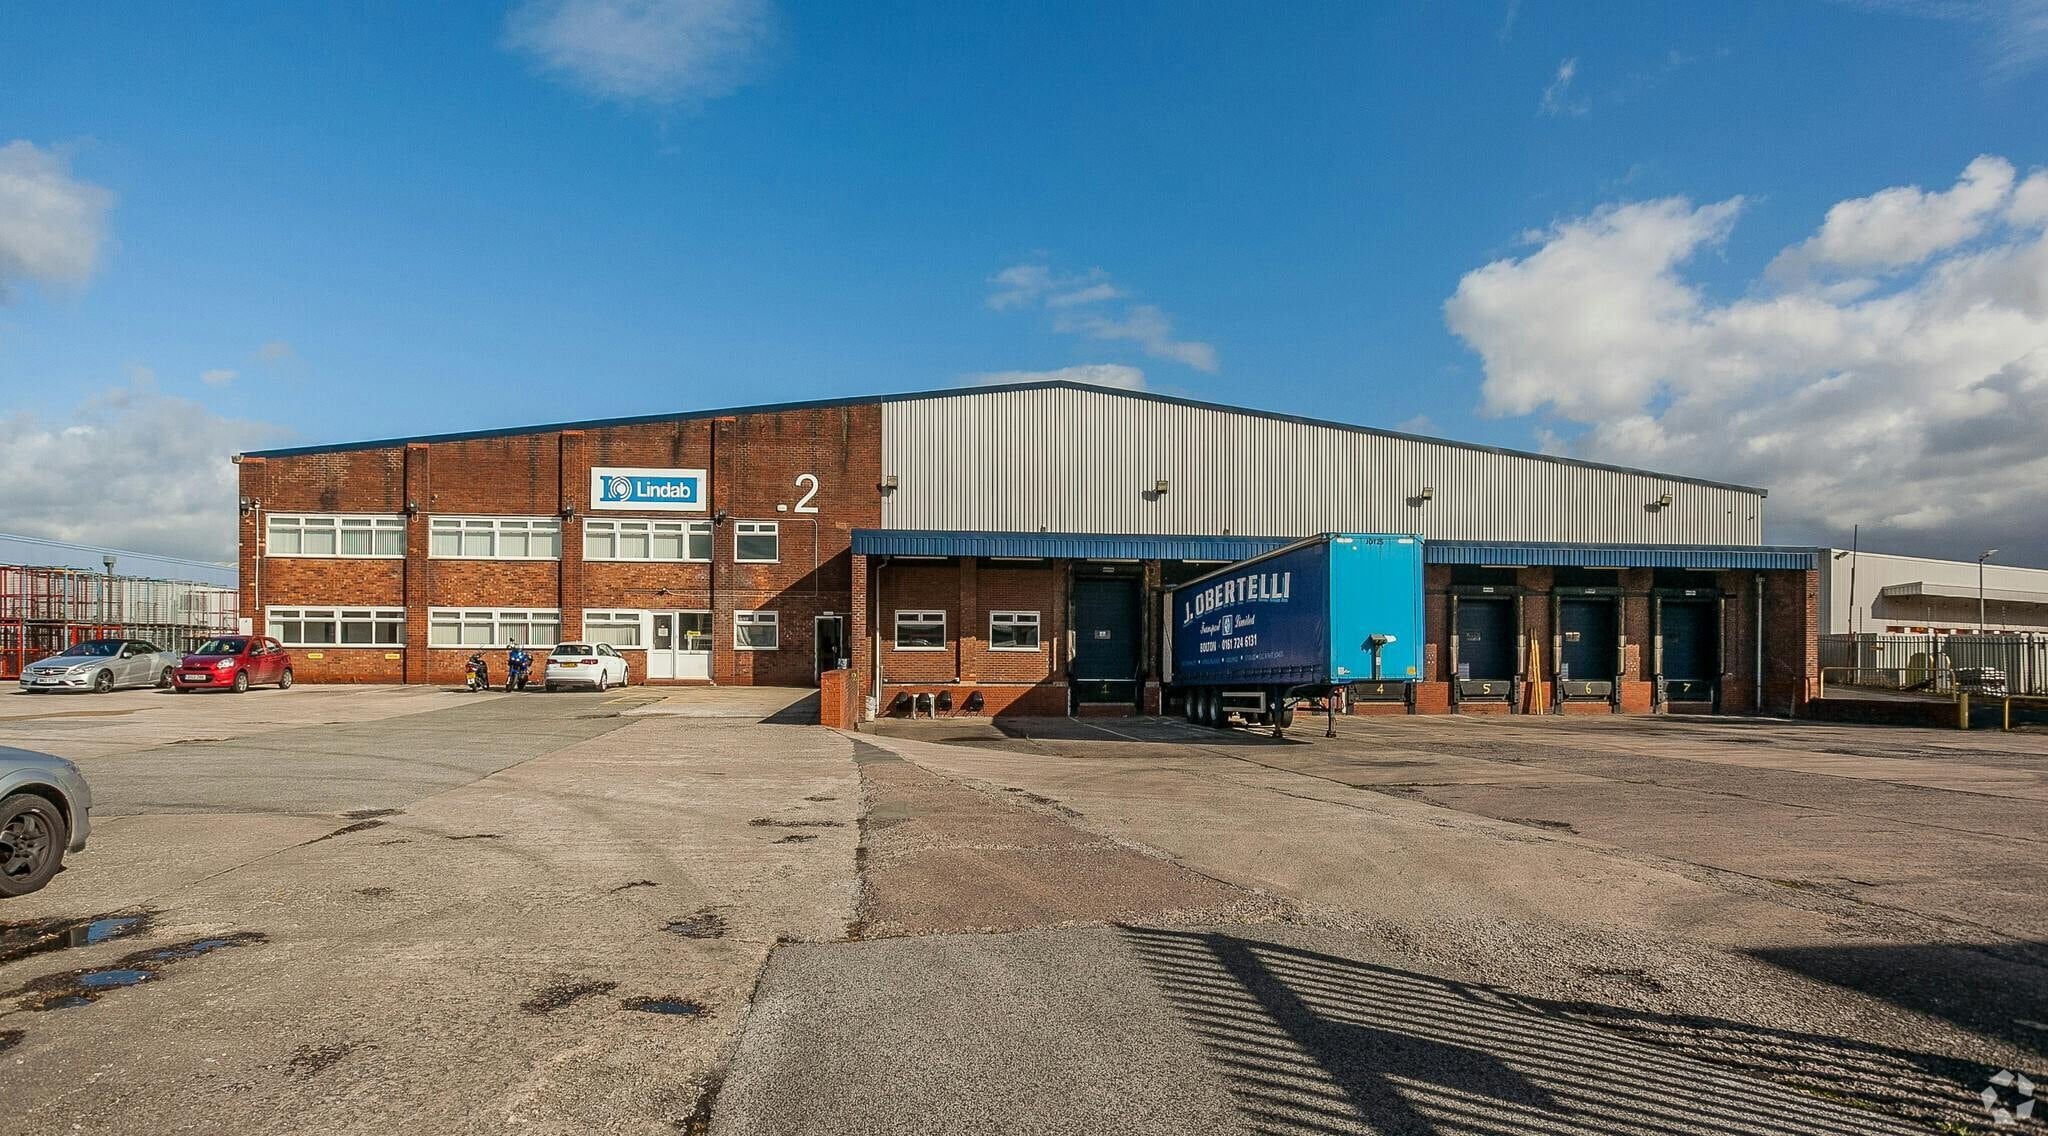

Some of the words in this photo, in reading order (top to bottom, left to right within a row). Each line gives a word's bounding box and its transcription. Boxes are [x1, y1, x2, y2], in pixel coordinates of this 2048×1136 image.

[637, 481, 691, 498] Lindab
[1195, 572, 1291, 616] OBERTELLI
[1233, 635, 1244, 649] 724
[1244, 633, 1257, 648] 6131
[1376, 683, 1385, 695] 4
[1482, 684, 1492, 694] 5
[1585, 684, 1593, 695] 6
[1683, 682, 1692, 692] 7
